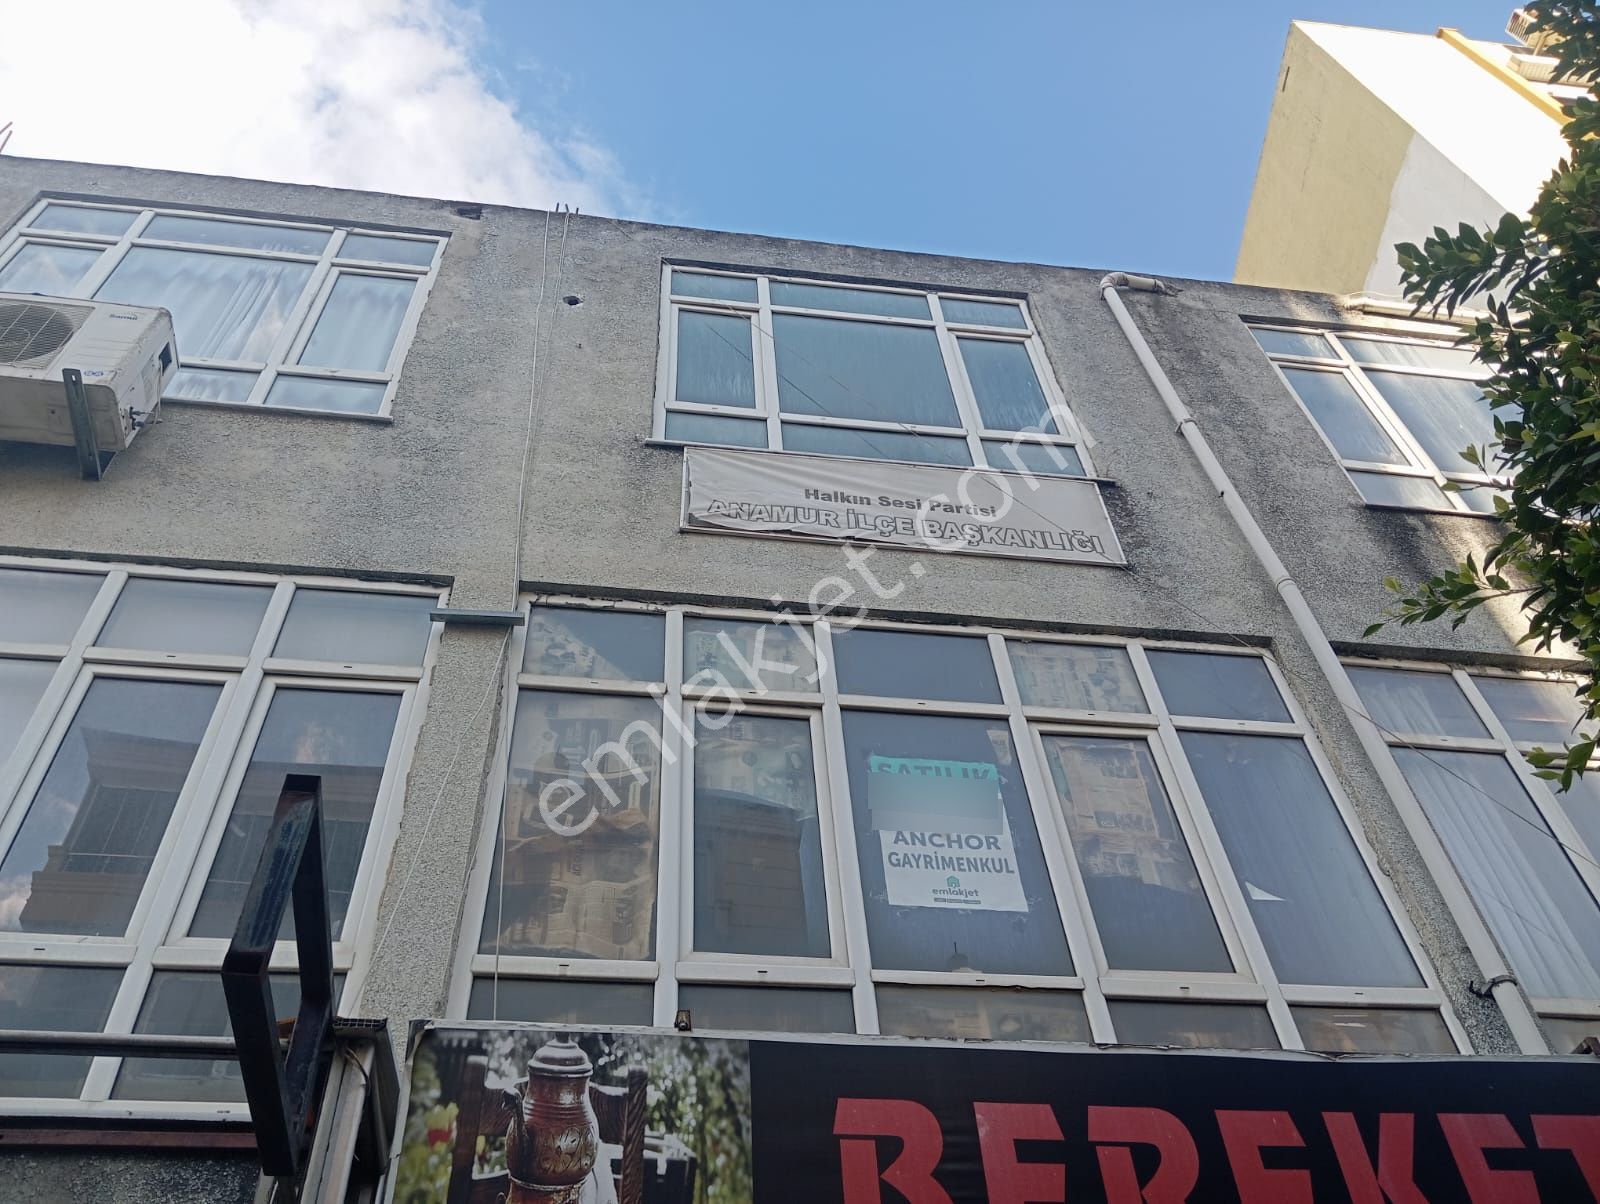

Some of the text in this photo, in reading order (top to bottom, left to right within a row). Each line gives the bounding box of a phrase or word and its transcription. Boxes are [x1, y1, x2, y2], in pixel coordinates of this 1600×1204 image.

[804, 488, 996, 517] Halkın Sesi Partisi
[707, 500, 1106, 554] ANAMUR İLÇE BAŞKANLIĞI
[893, 831, 1001, 850] ANCHOR
[887, 851, 1015, 874] GAYRİMENKUL
[932, 887, 979, 898] emlakjet
